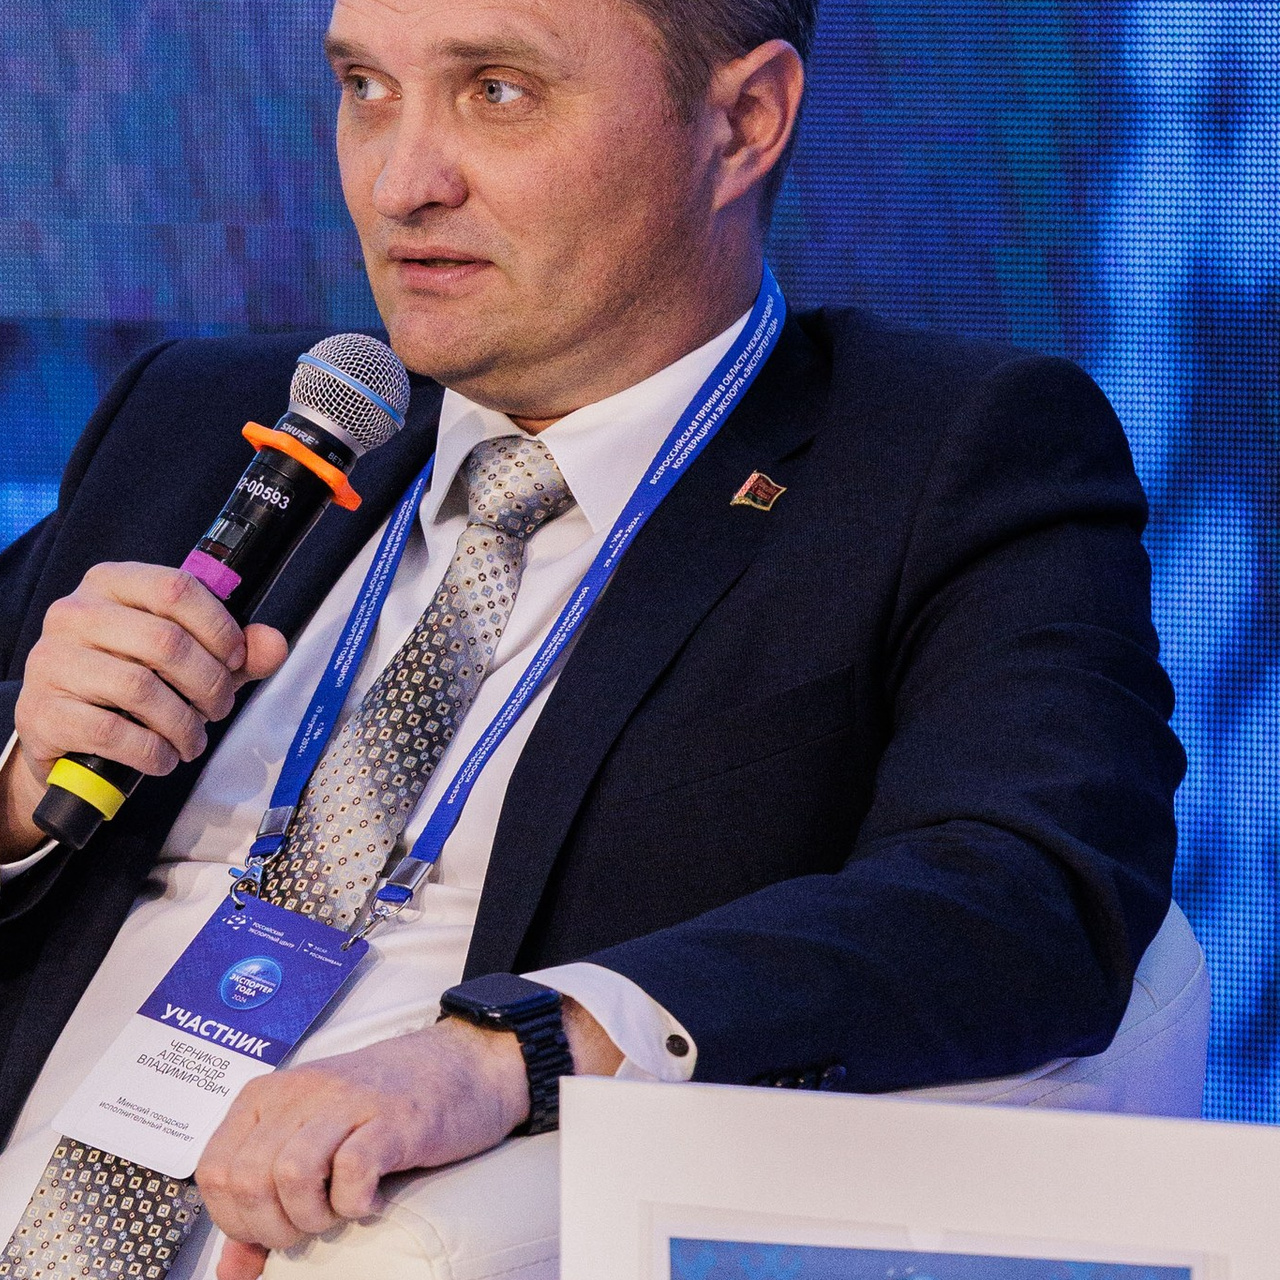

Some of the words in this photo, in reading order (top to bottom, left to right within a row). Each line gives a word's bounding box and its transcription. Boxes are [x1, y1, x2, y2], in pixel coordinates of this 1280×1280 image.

[745, 294, 774, 353] МЕЖДУНАРОДНОЙ
[721, 350, 749, 386] ОБЛАСТИ
[695, 389, 722, 421] ПРЕМИЯ
[717, 383, 726, 391] В
[280, 422, 317, 445] SHURE
[671, 418, 714, 468] КООПЕРАЦИИ
[710, 412, 719, 420] И
[715, 376, 745, 415] ЭКСПОРТА
[649, 419, 699, 482] ВСЕРОССИЙСКАЯ
[365, 580, 384, 617] ОБЛАСТИ
[334, 616, 369, 689] МЕЖДУНАРОДНОЙ
[229, 973, 274, 995] ЭКСПОРТЕР
[235, 984, 256, 998] ГОДА
[160, 1003, 271, 1057] УЧАСТНИК
[157, 1049, 226, 1081] АЛЕКСАНДР
[170, 1039, 231, 1070] ЧЕРНИКОВ
[137, 1053, 231, 1097] ВЛАДИМИРОВИЧ
[99, 1100, 162, 1131] исполнительный
[163, 1124, 195, 1143] комитет
[116, 1096, 151, 1115] Минский
[150, 1111, 190, 1131] городской
